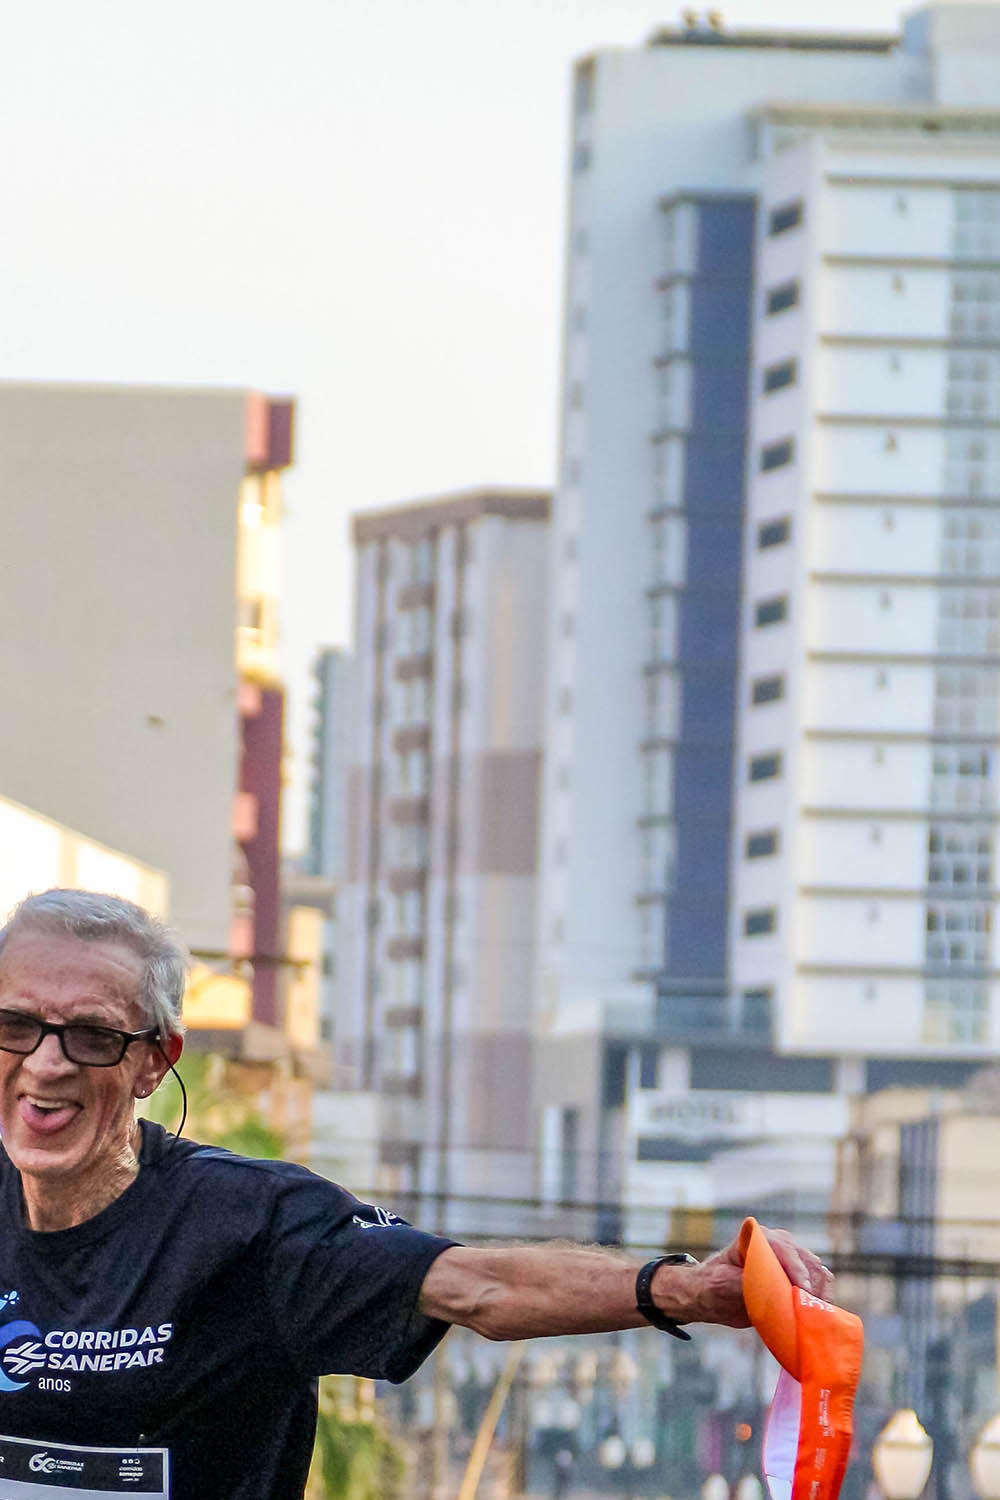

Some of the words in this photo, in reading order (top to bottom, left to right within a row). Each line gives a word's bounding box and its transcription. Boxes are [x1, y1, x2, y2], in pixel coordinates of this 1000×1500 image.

[44, 1323, 173, 1350] CORRIDAS
[47, 1347, 165, 1372] SANEPAR
[38, 1376, 72, 1392] anos
